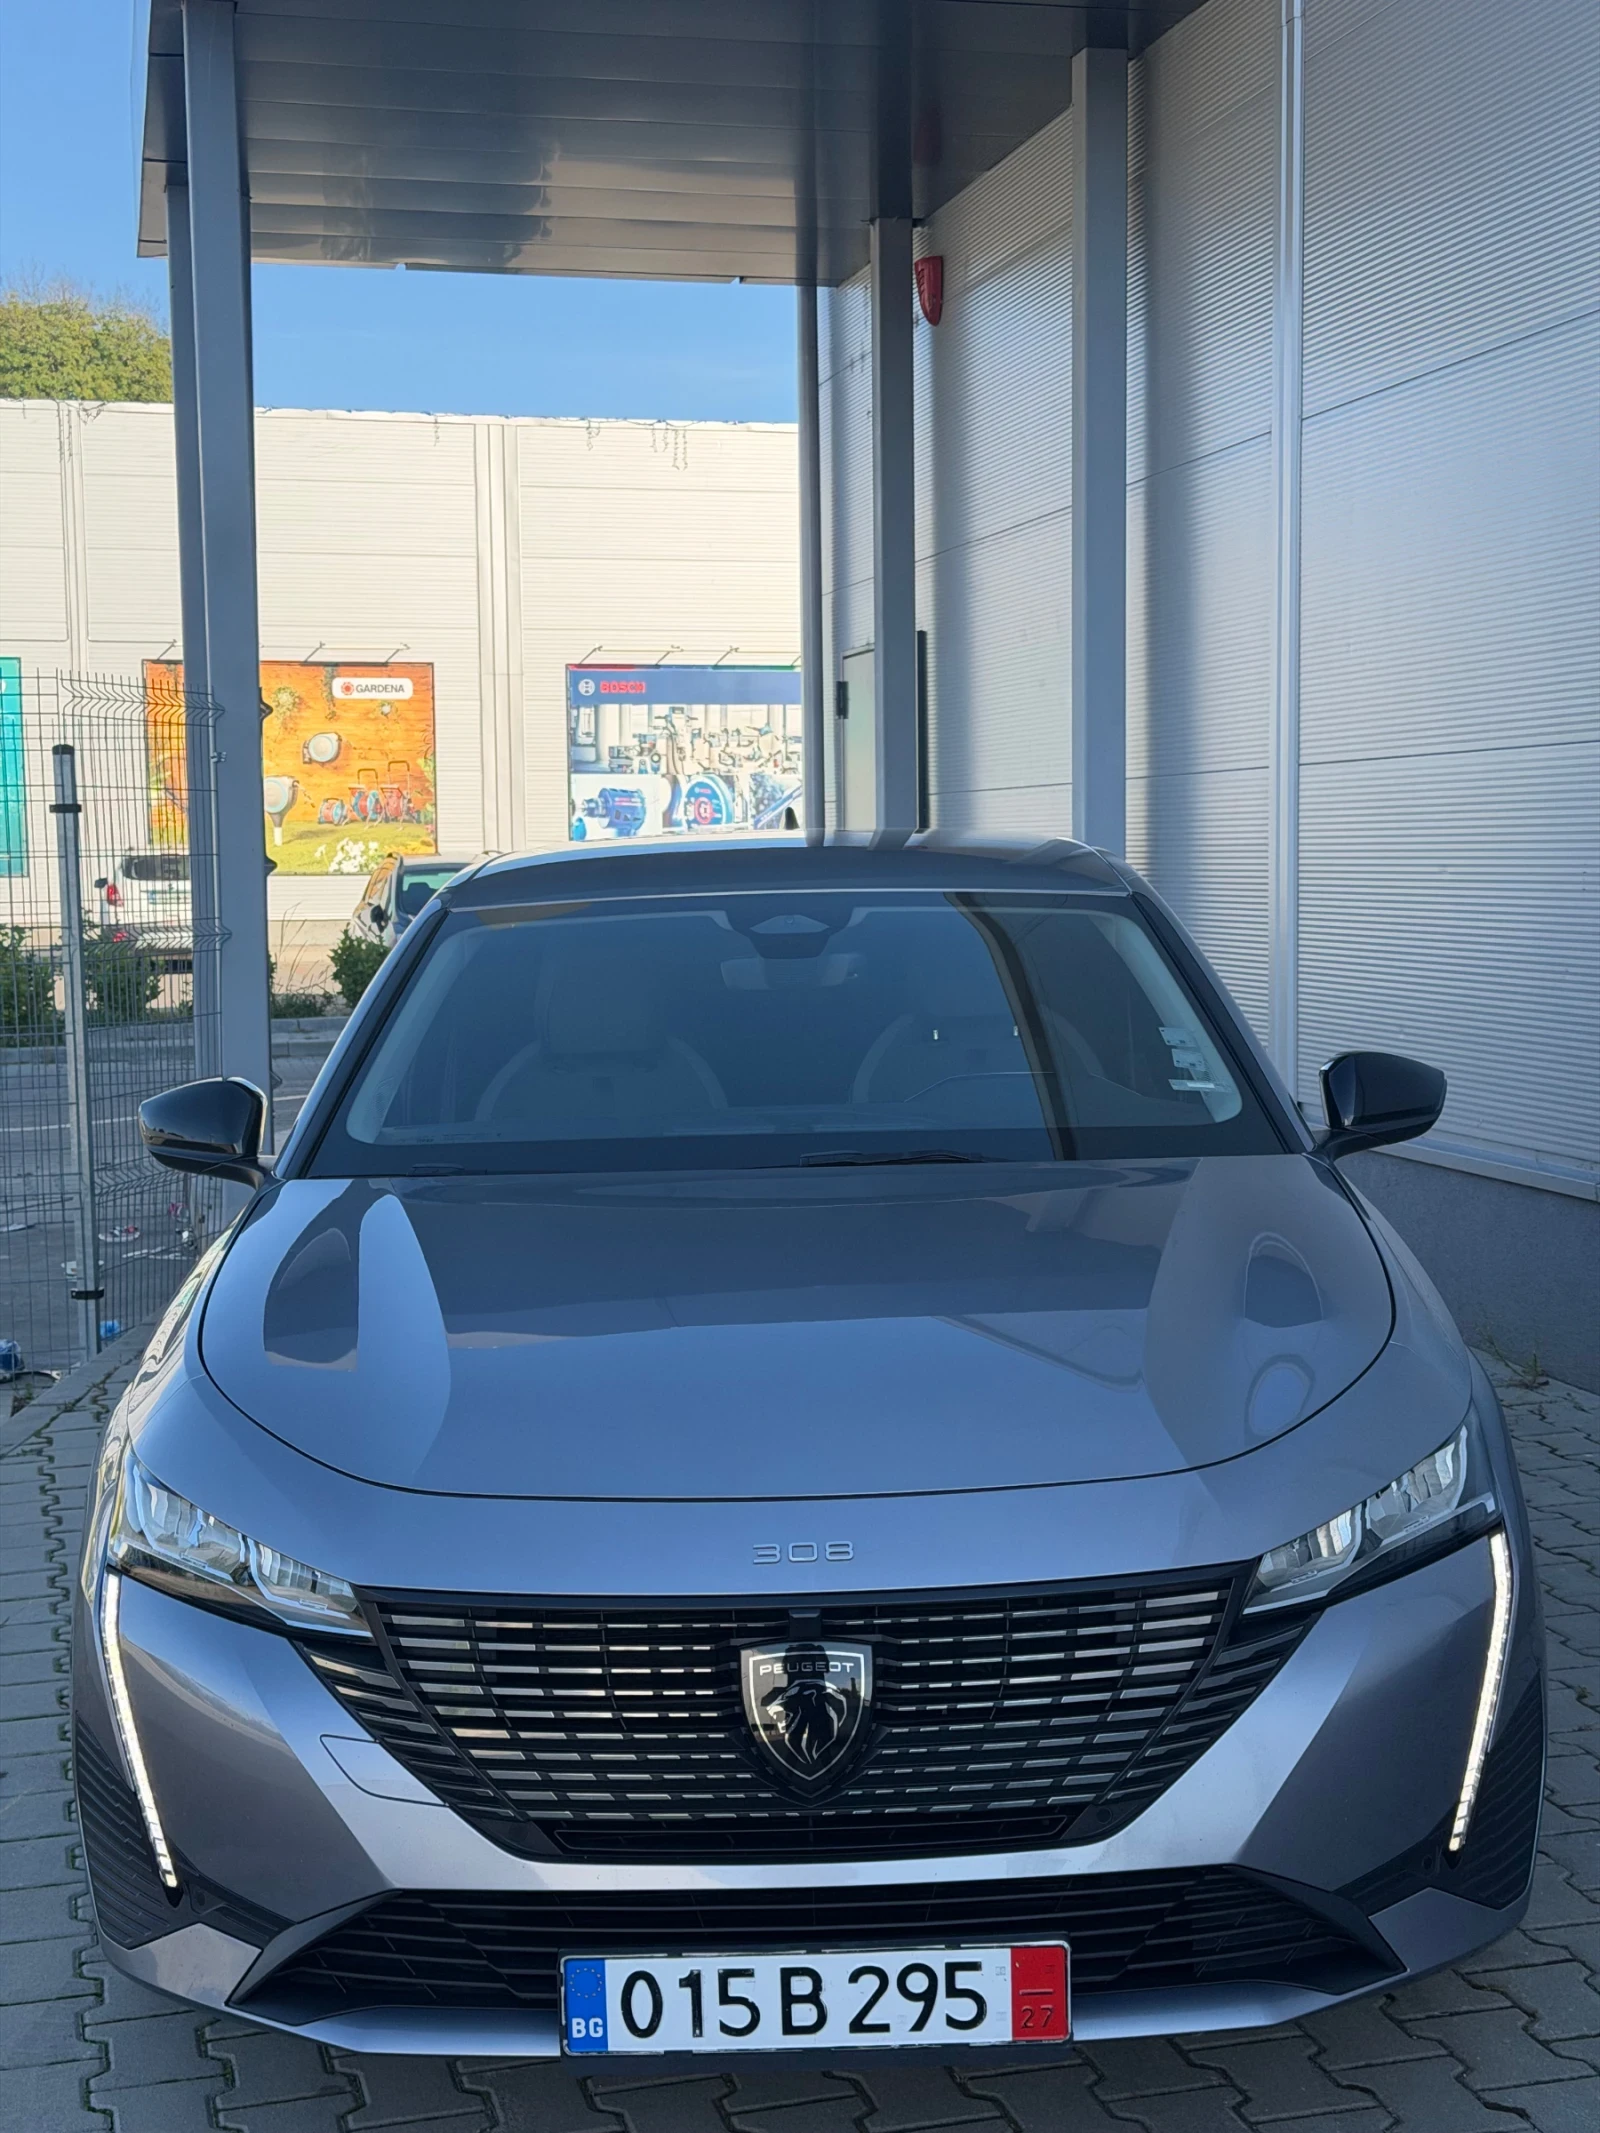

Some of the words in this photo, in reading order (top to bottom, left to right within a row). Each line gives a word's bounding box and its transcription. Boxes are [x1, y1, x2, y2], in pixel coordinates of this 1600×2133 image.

[355, 684, 405, 693] GARDENA
[600, 680, 646, 694] BOSCH
[753, 1540, 854, 1564] 308
[759, 1661, 855, 1676] PEUGEOT
[1021, 2005, 1054, 2029] 27
[572, 2017, 604, 2039] BG
